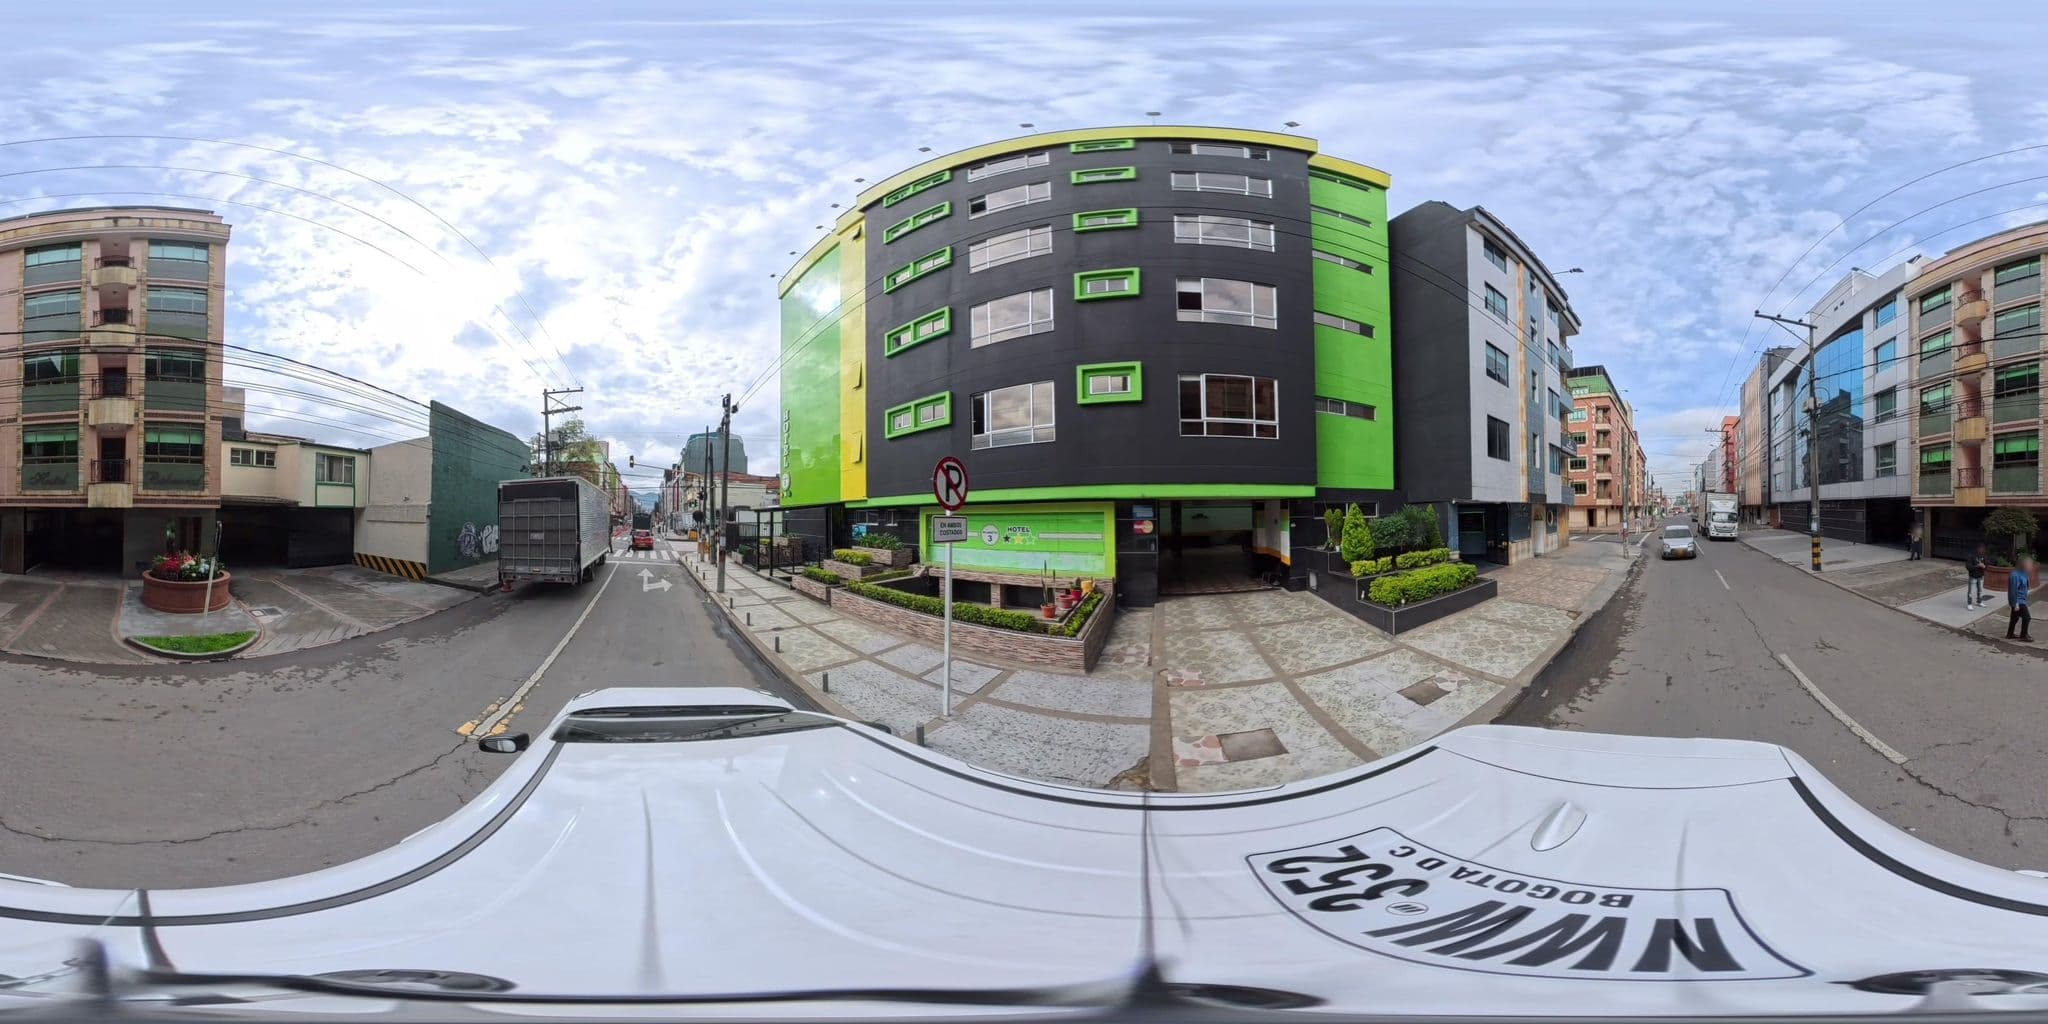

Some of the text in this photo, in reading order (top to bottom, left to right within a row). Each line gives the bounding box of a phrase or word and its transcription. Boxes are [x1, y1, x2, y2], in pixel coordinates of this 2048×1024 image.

[1266, 844, 1743, 973] NWW 352
[1388, 845, 1634, 908] BOGOTA D C
